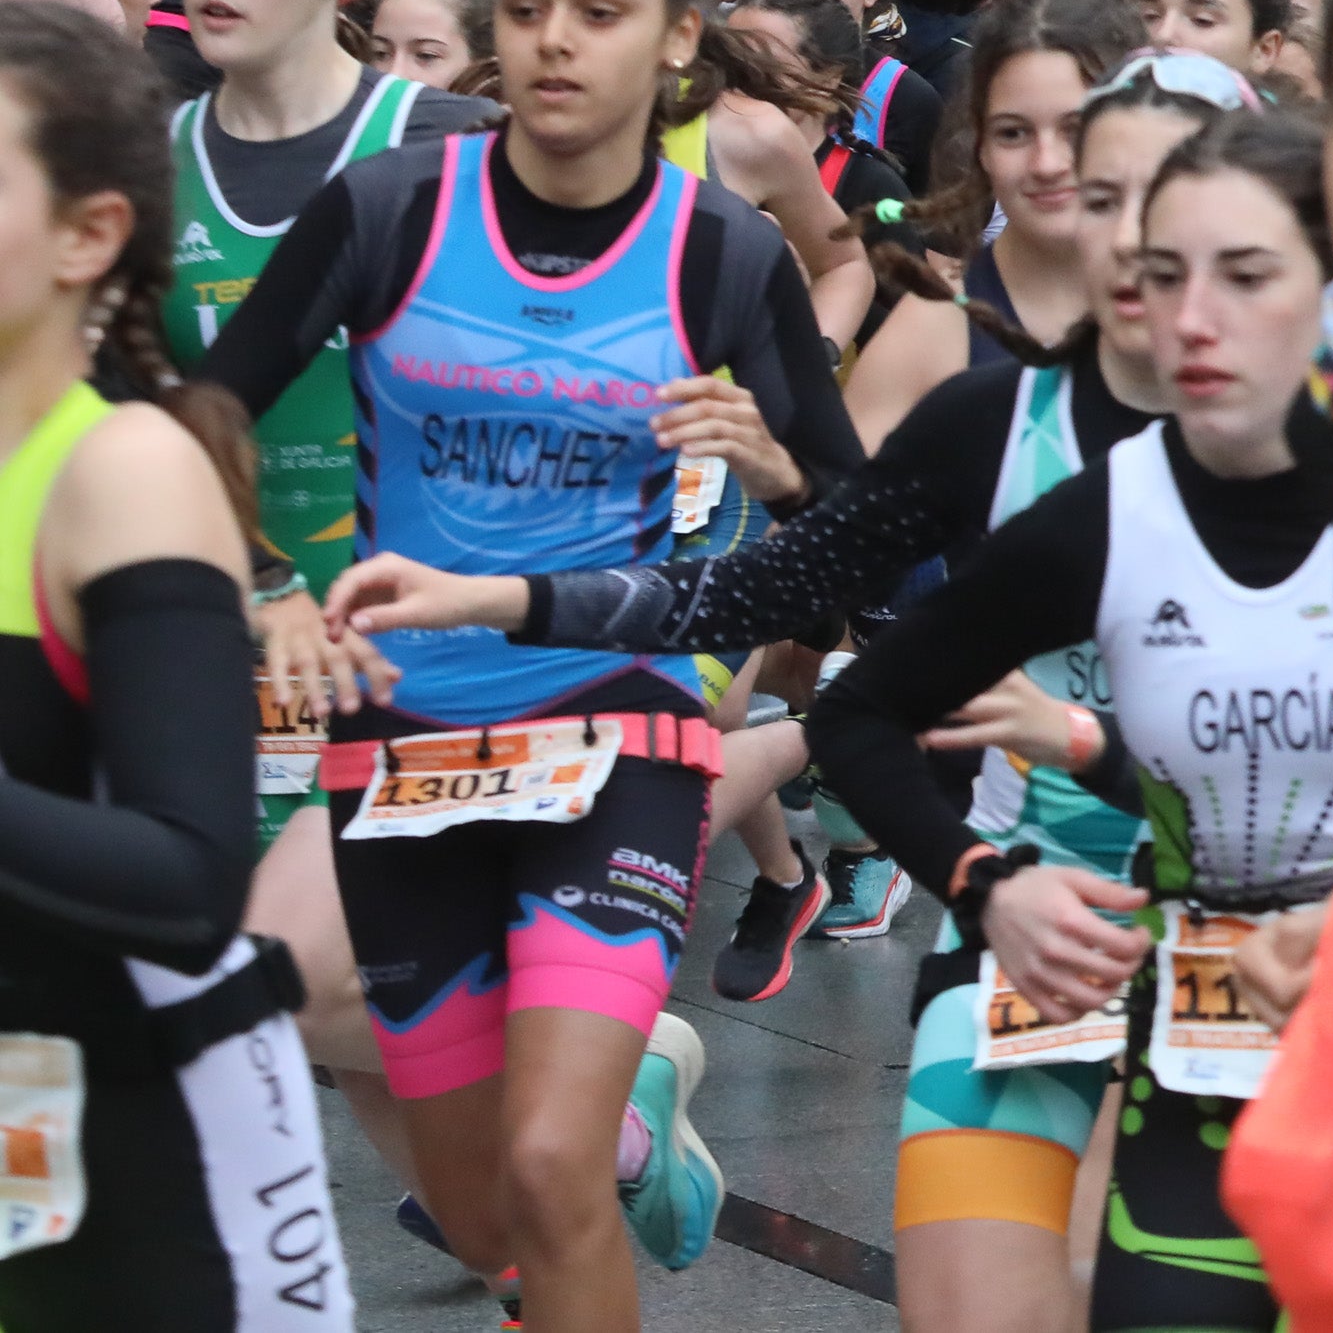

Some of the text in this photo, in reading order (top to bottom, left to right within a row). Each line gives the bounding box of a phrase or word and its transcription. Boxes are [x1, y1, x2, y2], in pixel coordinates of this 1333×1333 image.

[553, 377, 664, 409] NARO
[421, 414, 629, 489] SANCHEZ
[372, 769, 516, 807] 1301
